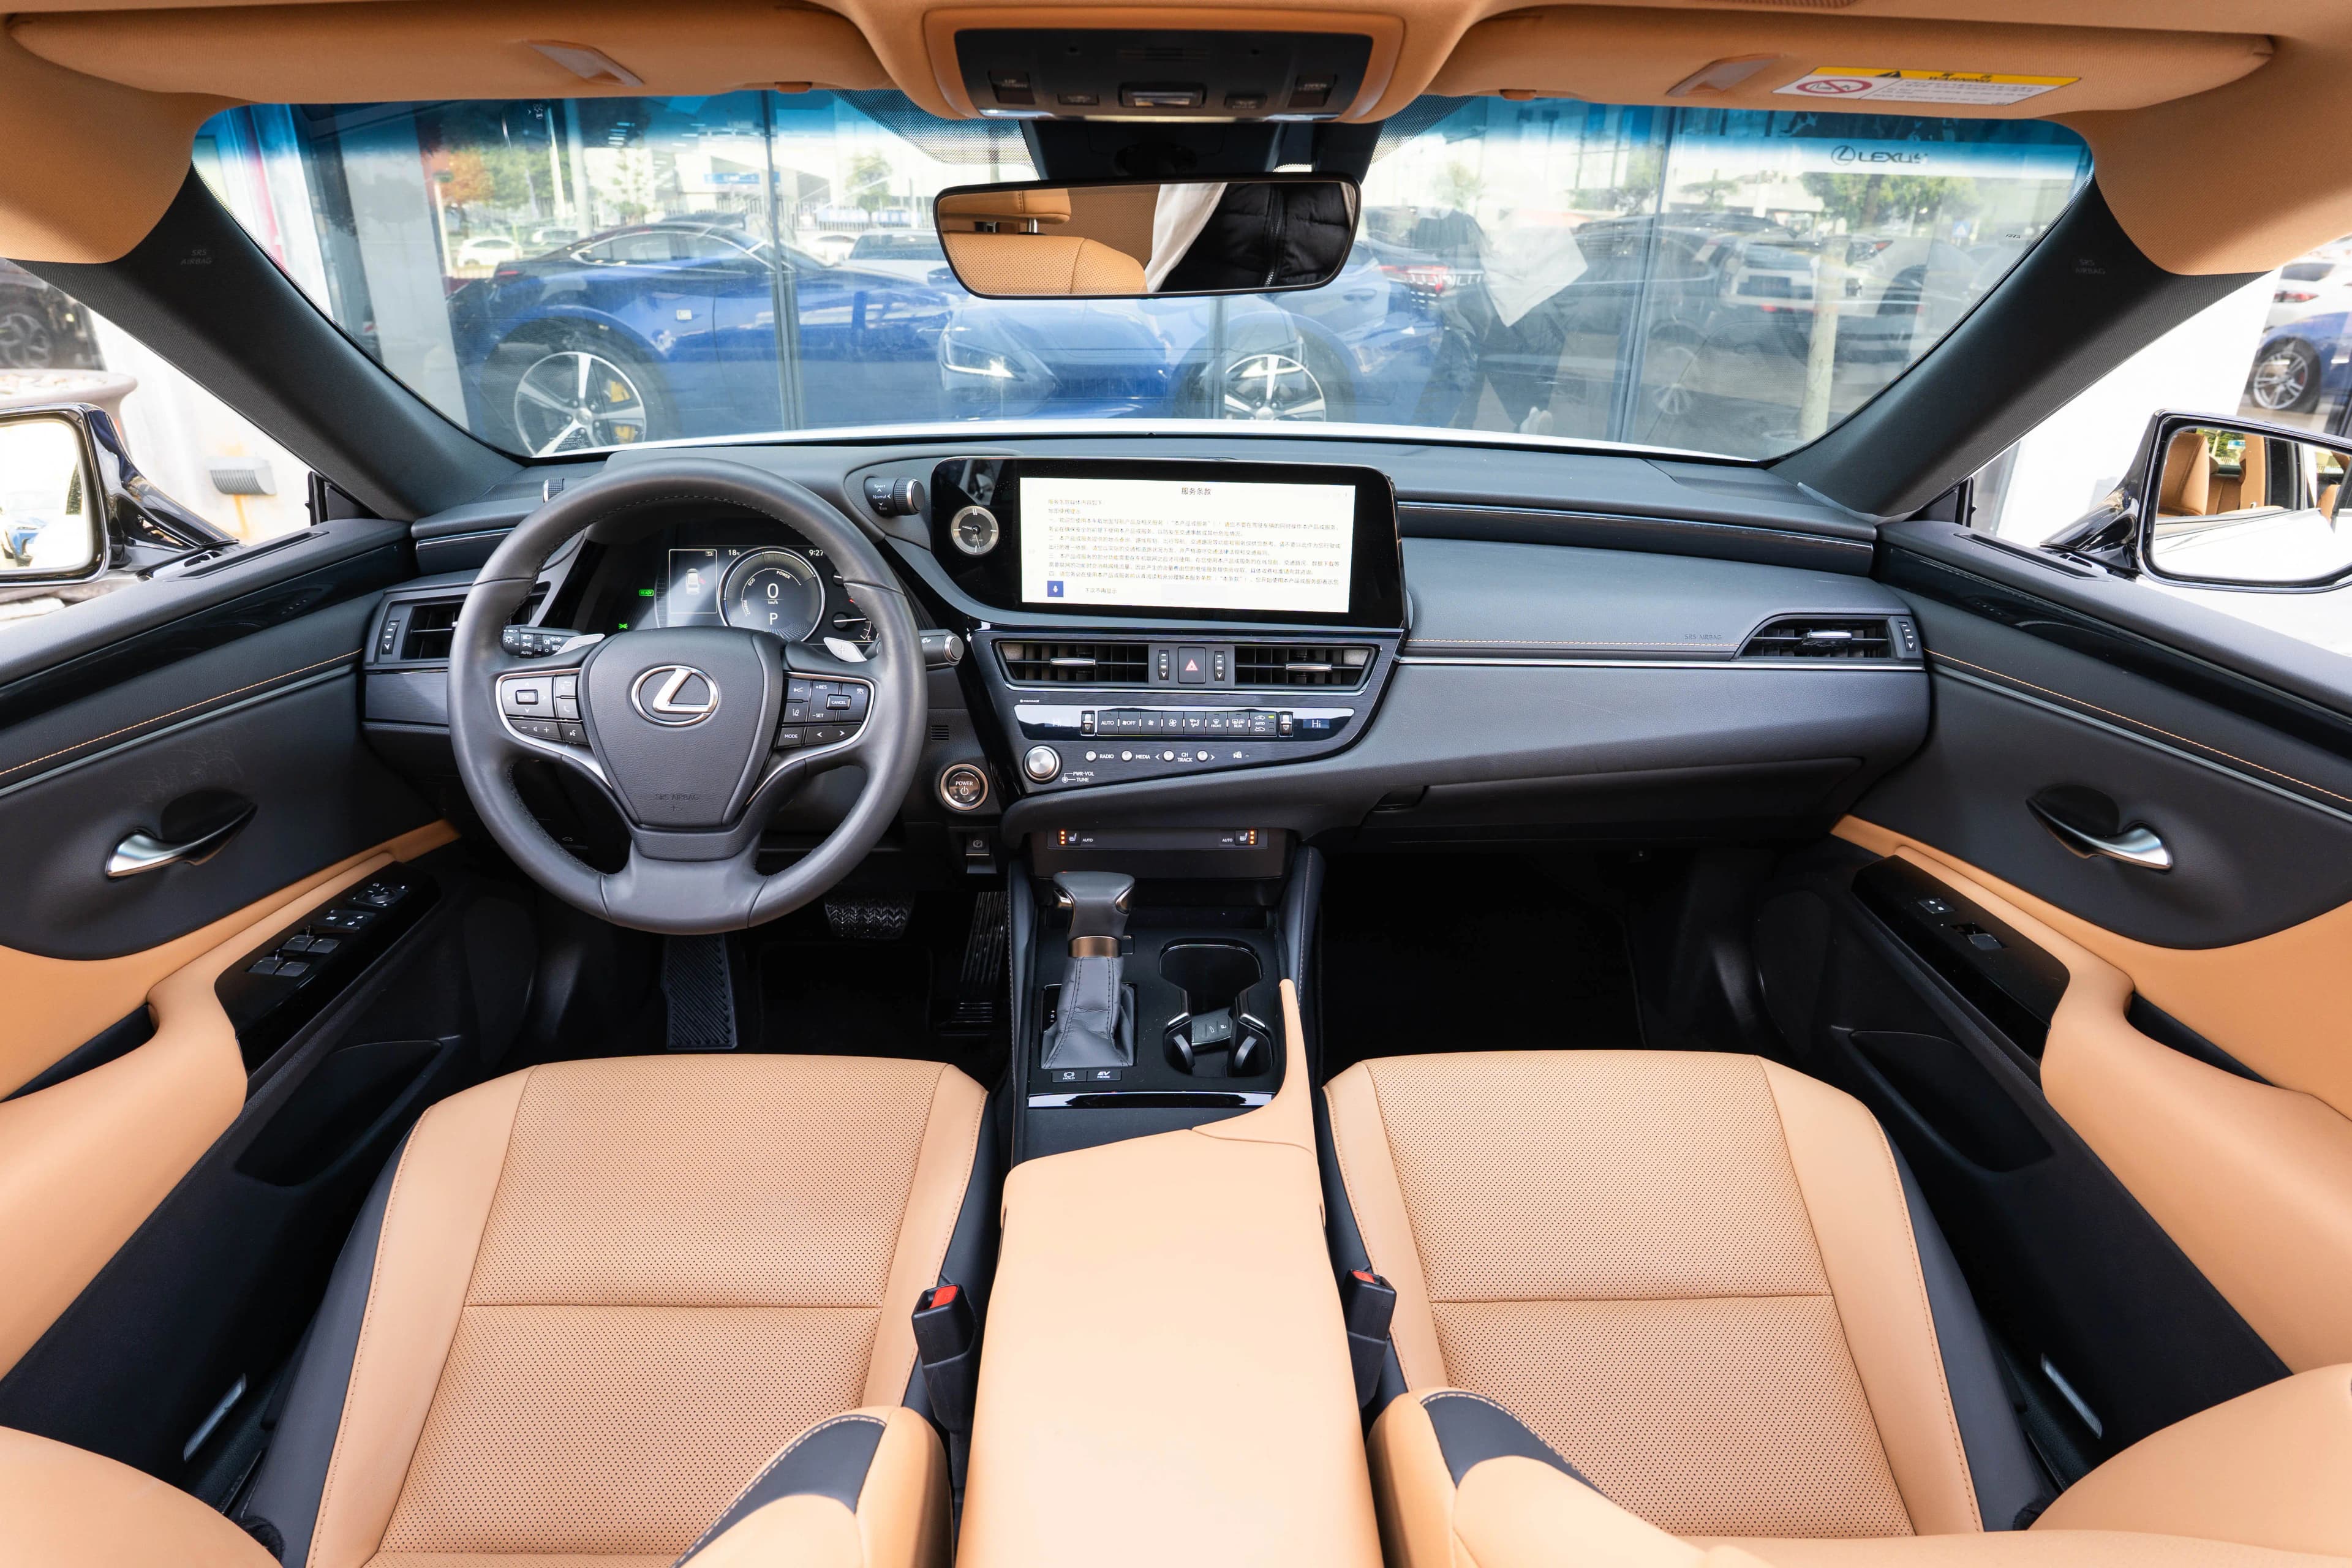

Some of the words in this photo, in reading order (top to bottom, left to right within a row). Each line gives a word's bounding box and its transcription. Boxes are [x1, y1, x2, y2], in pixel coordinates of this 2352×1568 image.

[1181, 487, 1212, 496] 服务条款
[776, 570, 791, 579] POWER
[769, 612, 778, 625] P
